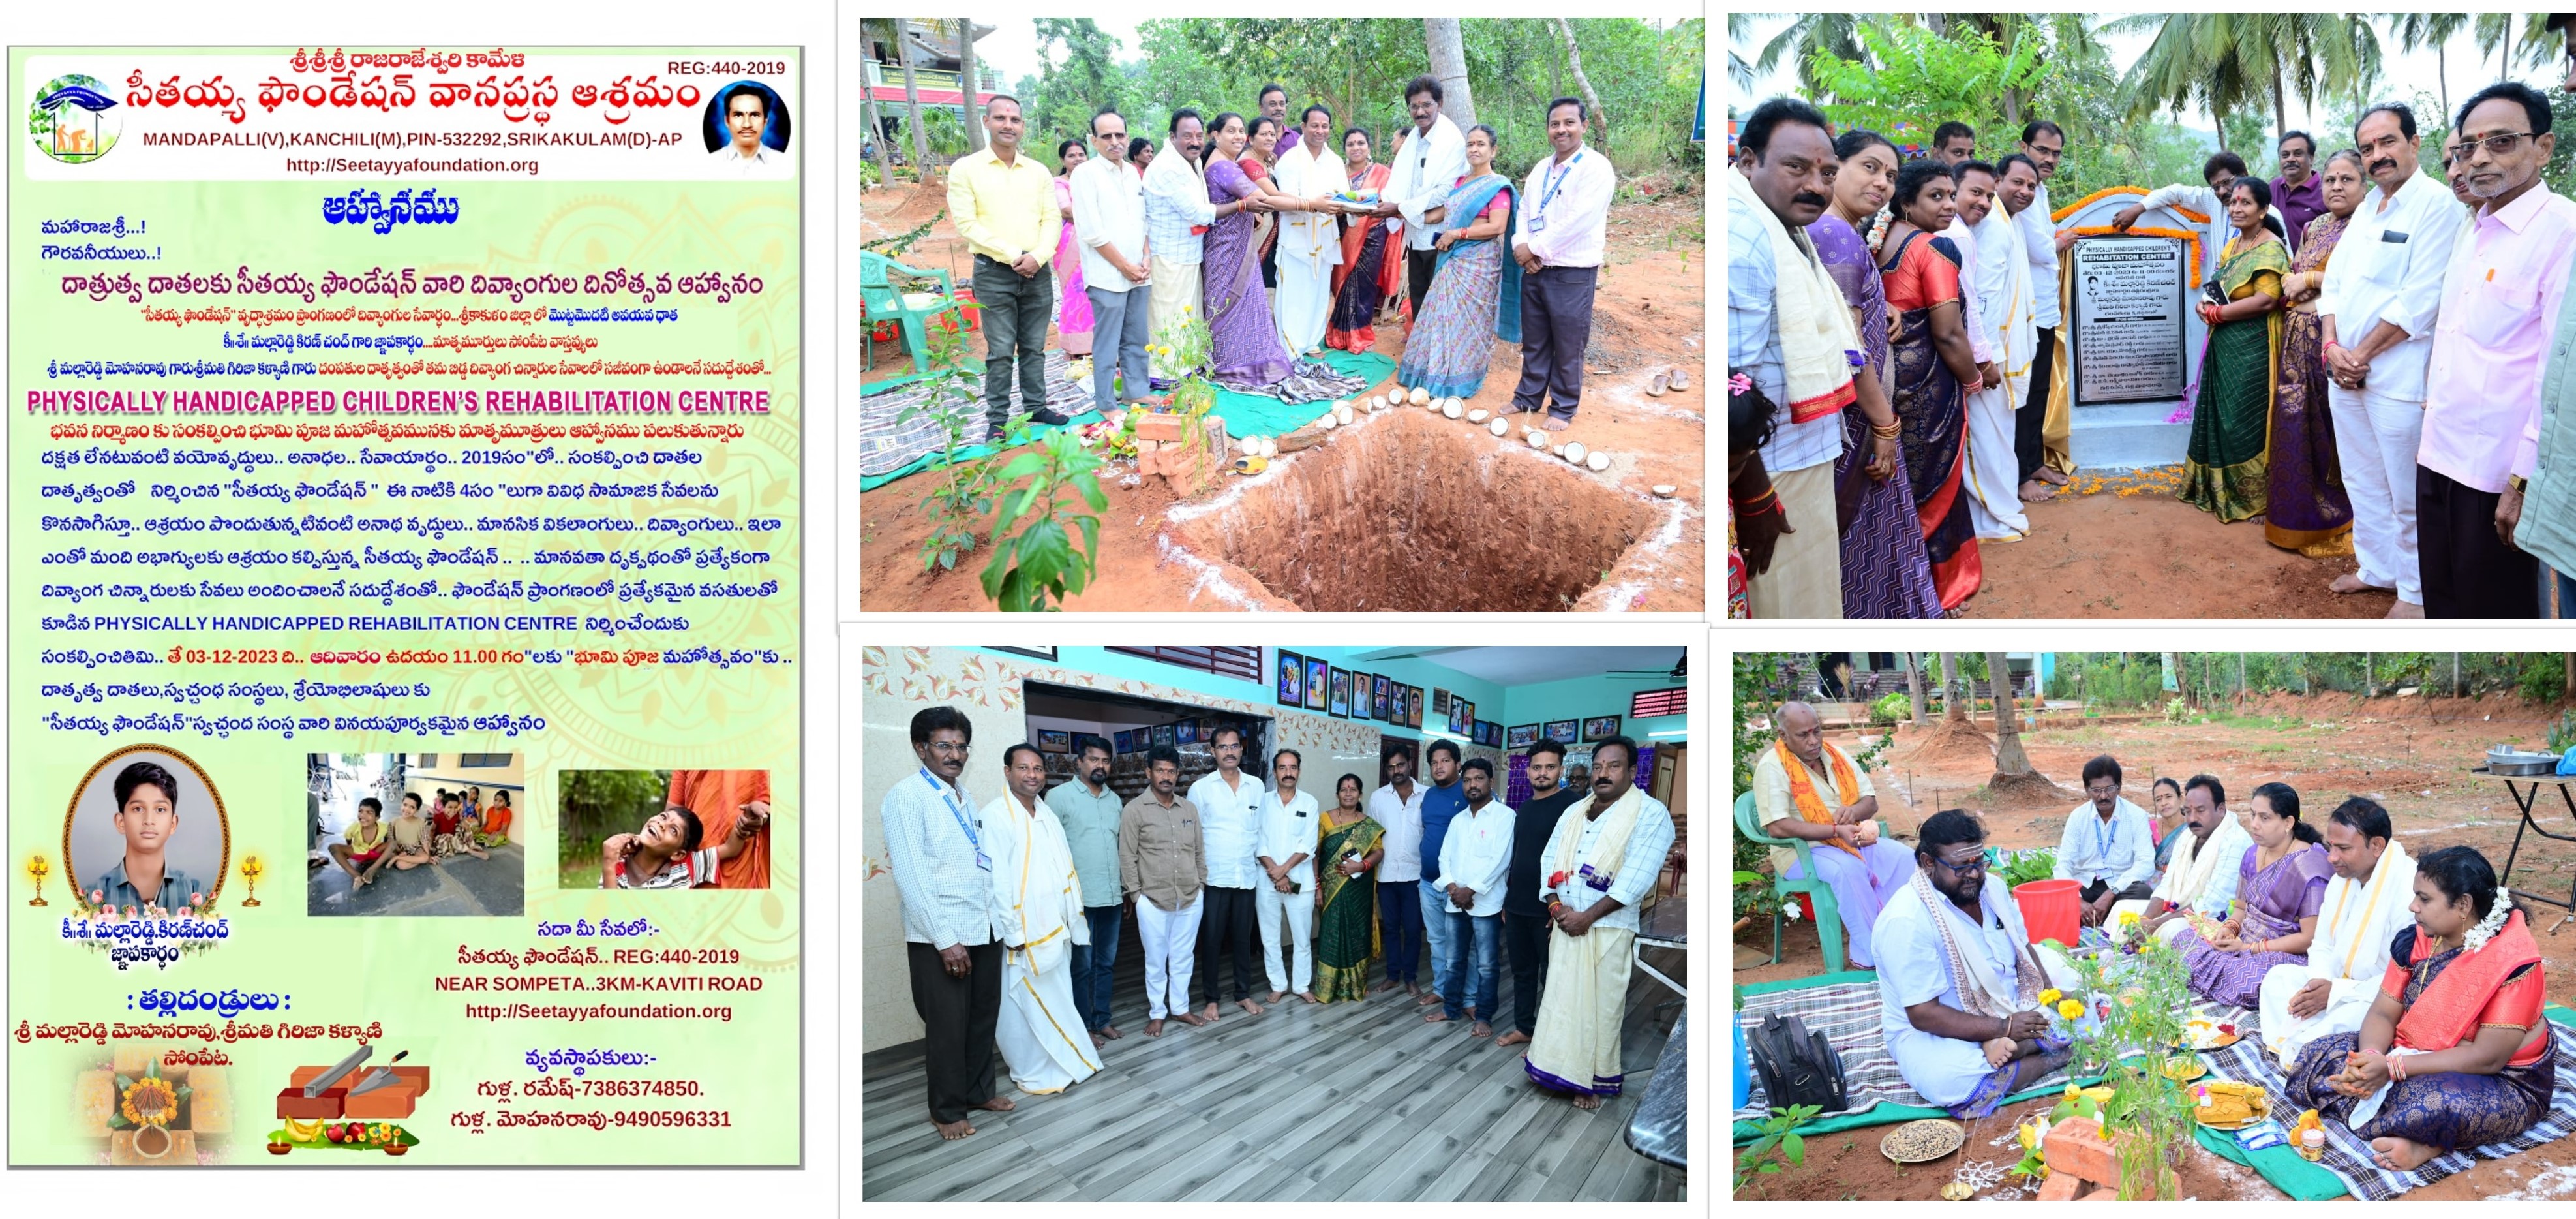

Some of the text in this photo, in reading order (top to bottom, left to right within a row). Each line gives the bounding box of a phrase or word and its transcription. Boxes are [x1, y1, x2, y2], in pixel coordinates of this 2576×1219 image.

[350, 48, 462, 74] రాజరాజేశ్వరి
[669, 62, 785, 74] REG:440-2019
[127, 65, 701, 127] సీతయ్య ఫౌండేషన్ వానప్రస్థ ఆశ్రమం
[144, 132, 682, 149] MANDAPALLI(V),KANCHILI(M),PIN-532292,SRIKAKULAM(D)-AP
[288, 158, 538, 175] http://Seetayyafoundation.org
[322, 188, 460, 235] ఆహ్వానము
[148, 273, 232, 294] దాతలకు
[237, 266, 315, 303] సీతయ్య
[321, 267, 416, 298] ఫౌండేషన్
[423, 275, 464, 294] వారి
[471, 273, 577, 303] దివ్యాంగుల
[584, 268, 672, 303] దినోత్సవ
[678, 272, 763, 303] ఆహ్వానం
[28, 391, 769, 412] PHYSICALLY HANDICAPPED CHILDREN’S REHABILITATION CENTRE
[51, 424, 88, 440] భవన
[92, 425, 149, 445] నిర్మాణం
[153, 424, 169, 438] కు
[172, 424, 246, 443] సంకల్పించి
[250, 424, 292, 440] భూమి
[296, 424, 330, 442] పూజ
[334, 420, 455, 442] మహోత్సవమునకు
[570, 422, 640, 444] ఆహ్వానము
[42, 450, 80, 470] దక్షత
[84, 447, 169, 464] లేనటువంటి
[568, 450, 648, 469] సంకల్పించి
[653, 450, 702, 464] దాతల
[42, 480, 718, 504] దాతృత్వంతో నిర్మించిన ఫౌండేషన్ ఈ నాటికి 4సం వివిధ సామాజిక సేవలను
[145, 517, 205, 535] ఆశ్రయం
[357, 517, 402, 532] అనాథ
[407, 517, 472, 540] వృద్ధులు..
[477, 516, 539, 531] మానసిక
[543, 517, 643, 531] వికలాంగులు..
[748, 519, 781, 531] ఇలా
[42, 546, 770, 570] ఎంతో మంది అభాగ్యులకు ఆశ్రయం కల్పిస్తున్న సీతయ్య ఫౌండేషన్ మానవతా ప్రత్యేకంగా
[42, 579, 778, 603] దివ్యాంగ చిన్నారులకు సేవలు అందించాలనే ఫౌండేషన్ ప్రాంగణంలో ప్రత్యేకమైన వసతులతో
[42, 614, 90, 630] కూడిన
[95, 617, 207, 630] PHYSICALLY
[213, 617, 344, 630] HANDICAPPED
[349, 617, 499, 630] REHABILITATION
[504, 617, 577, 630] CENTRE
[168, 646, 182, 663] తే
[186, 650, 277, 663] 03-12-2023
[282, 651, 303, 663] ది..
[311, 650, 381, 664] ఆదివారం
[386, 649, 448, 663] ఉదయం
[453, 650, 497, 663] 11.00
[567, 650, 618, 666] "భూమి
[623, 649, 659, 666] పూజ
[42, 683, 102, 703] దాతృత్వ
[228, 683, 288, 706] సంస్థలు,
[414, 683, 430, 696] కు
[258, 716, 294, 739] సంస్థ
[299, 718, 330, 730] వారి
[474, 714, 545, 737] ఆహ్వానం
[538, 918, 659, 936] సదా మీ సేవలో:-
[458, 945, 739, 970] సీతయ్య ఫౌండేషన్.. REG:440-2019
[436, 977, 762, 991] NEAR SOMPETA..3KM-KAVITI ROAD
[466, 1004, 731, 1021] http://Seetayyafoundation.org
[14, 1020, 31, 1043] శ్రీ
[36, 1023, 108, 1045] మల్లారెడ్డి
[277, 1023, 325, 1038] గిరిజా
[328, 1022, 383, 1045] కళ్యాణి
[164, 1047, 232, 1068] సోంపేట.
[478, 1081, 517, 1103] గుళ్ల.
[451, 1111, 491, 1134] గుళ్ల.
